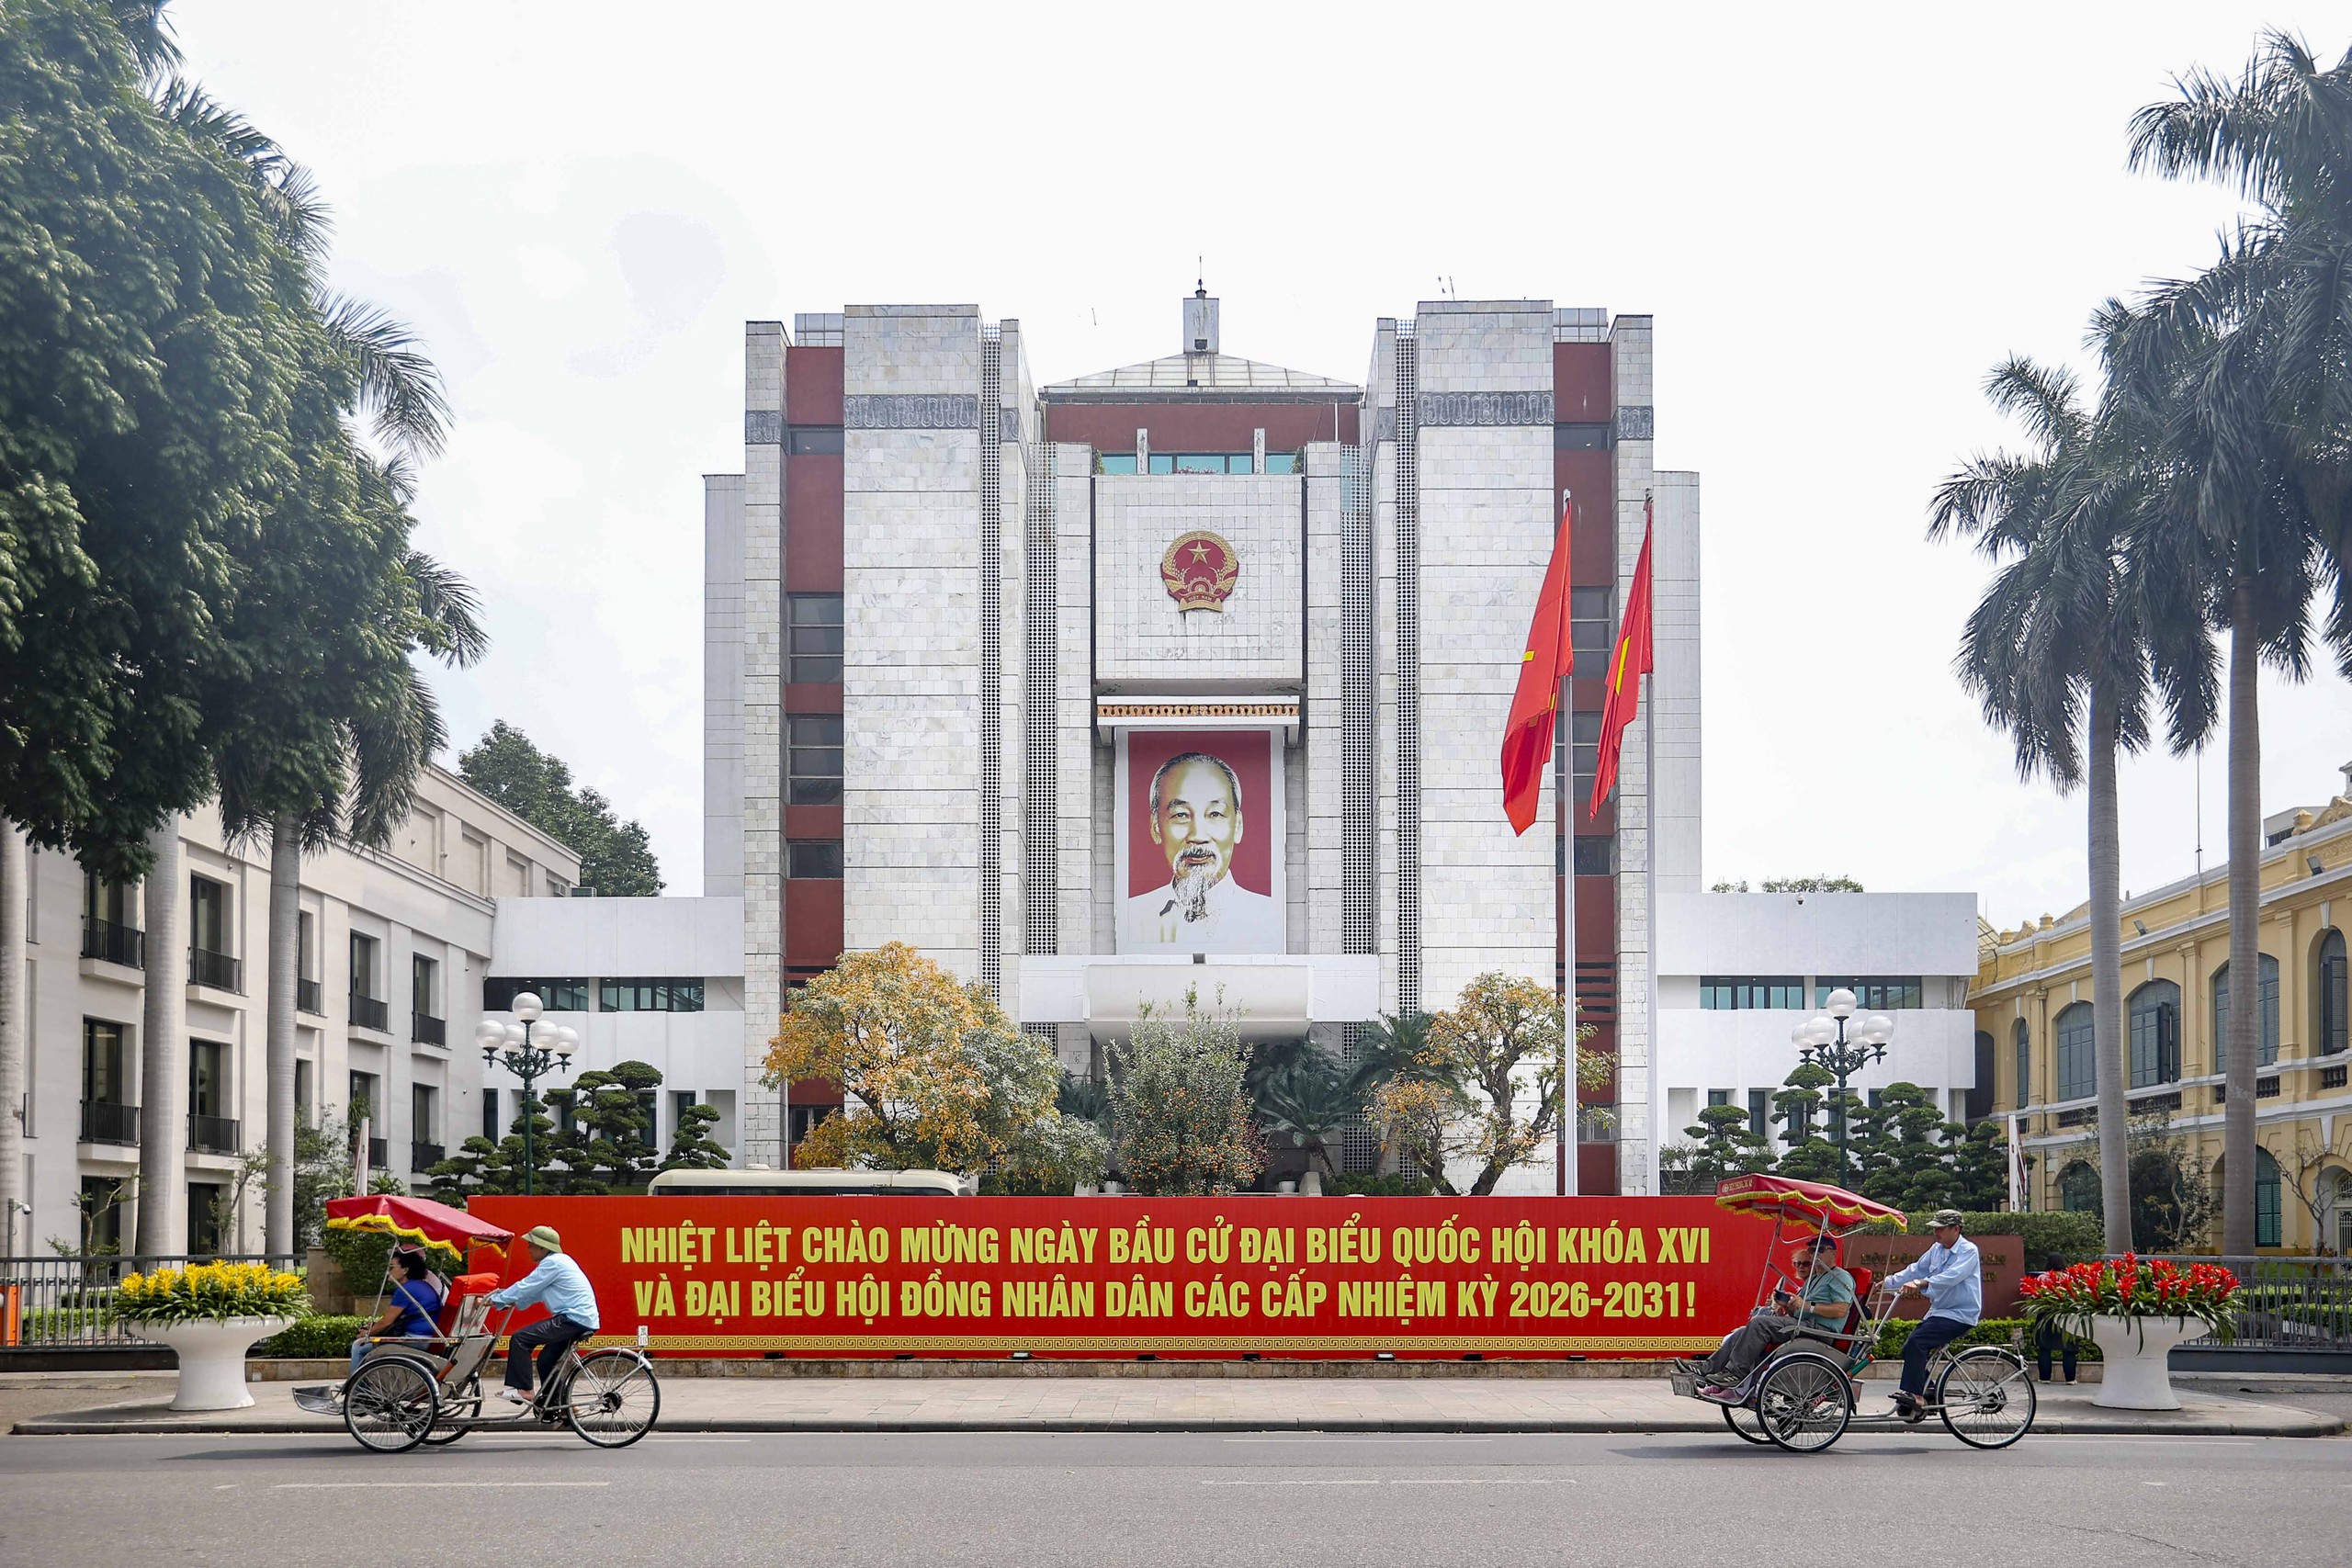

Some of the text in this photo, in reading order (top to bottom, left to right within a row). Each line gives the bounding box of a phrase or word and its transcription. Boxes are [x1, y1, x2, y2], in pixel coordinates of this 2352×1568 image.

[622, 1213, 1709, 1272] NHIỆT LIỆT CHÀO MỪNG NGÀY BẦU CỬ ĐẠI BIỂU QUỐC HỘI KHÓA XVI
[634, 1266, 1695, 1325] VÀ ĐẠI BIỂU HỘI ĐỒNG NHÂN DÂN CÁC CẤP NHIỆM KỲ 2026-2031!
